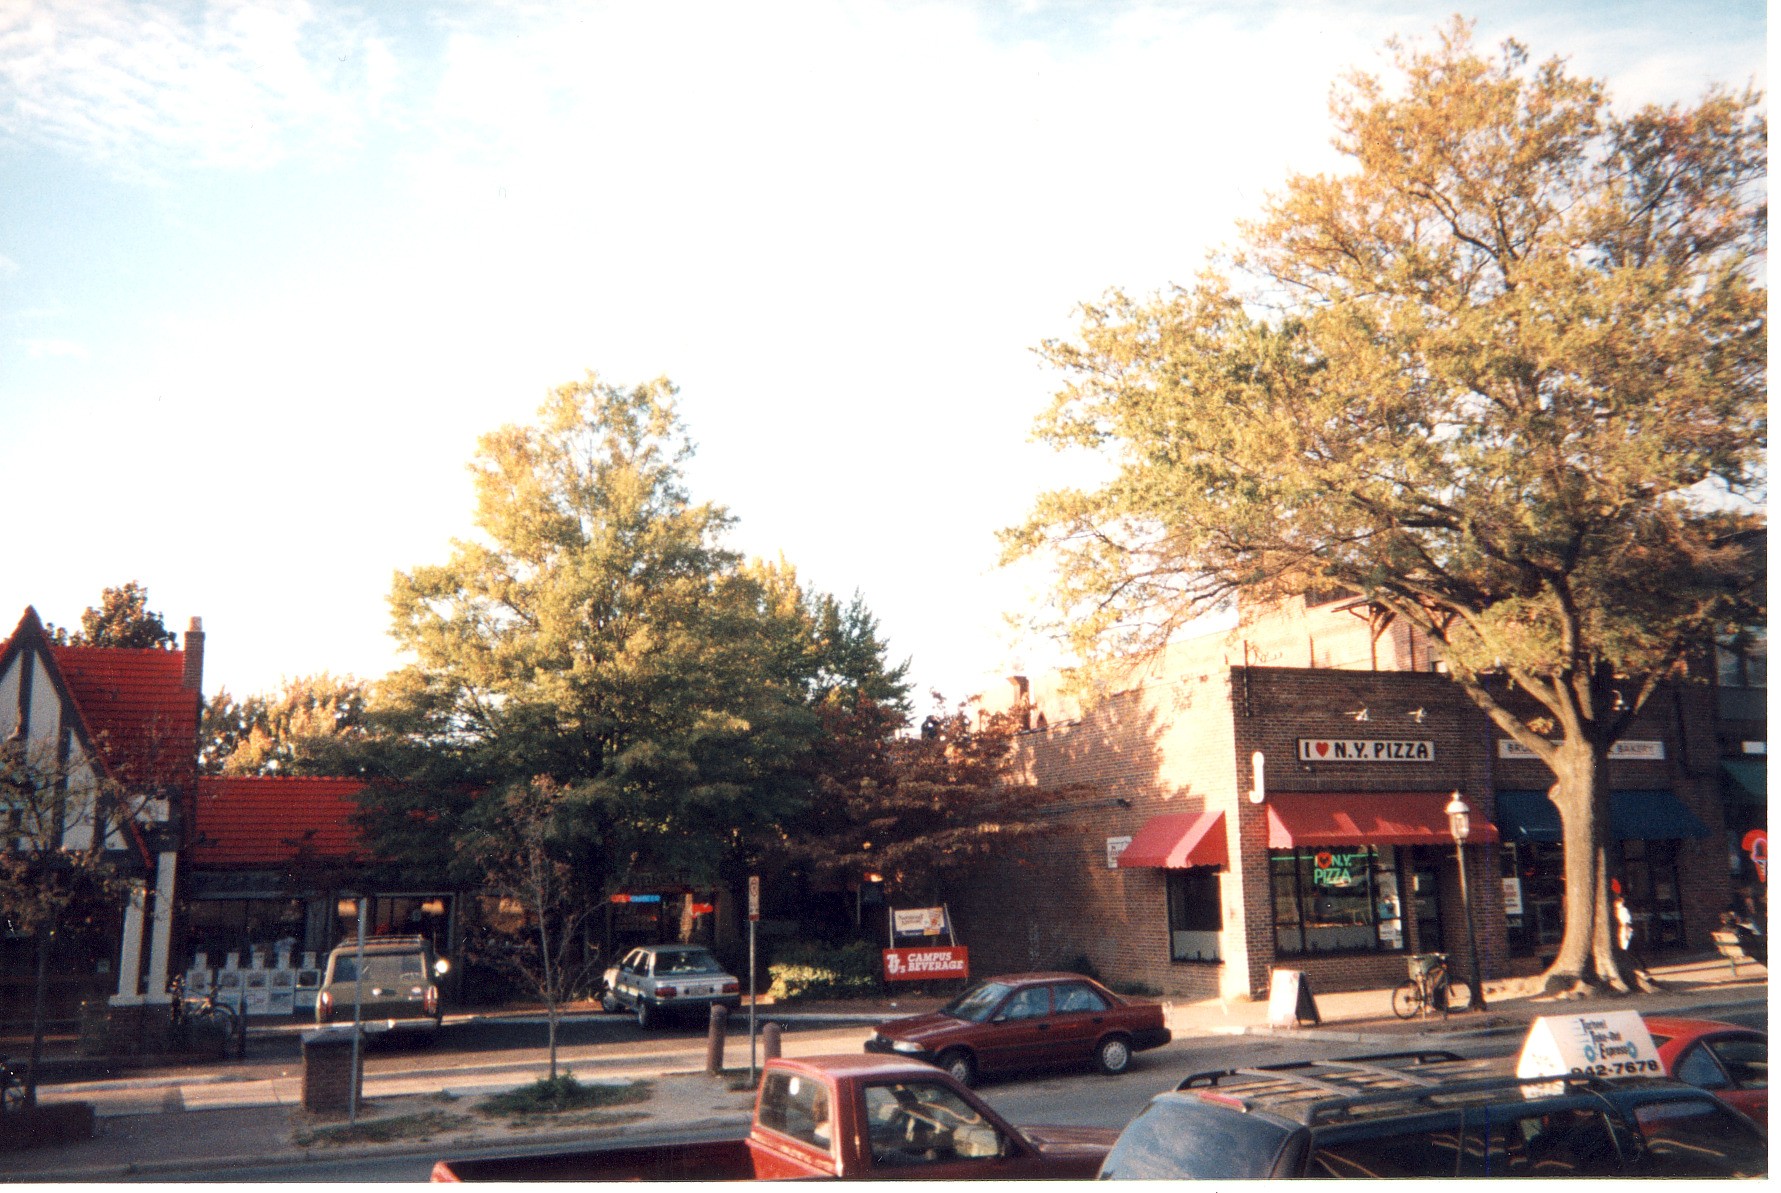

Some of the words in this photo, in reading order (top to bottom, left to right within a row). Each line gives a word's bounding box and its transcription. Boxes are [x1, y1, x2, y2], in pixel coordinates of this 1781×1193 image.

[1305, 742, 1310, 758] I
[1334, 742, 1368, 758] N.Y.
[1374, 742, 1428, 759] PIZZA
[1314, 868, 1352, 885] PIZZA
[908, 952, 952, 962] CAMPUS
[908, 960, 964, 972] BEVERAGE
